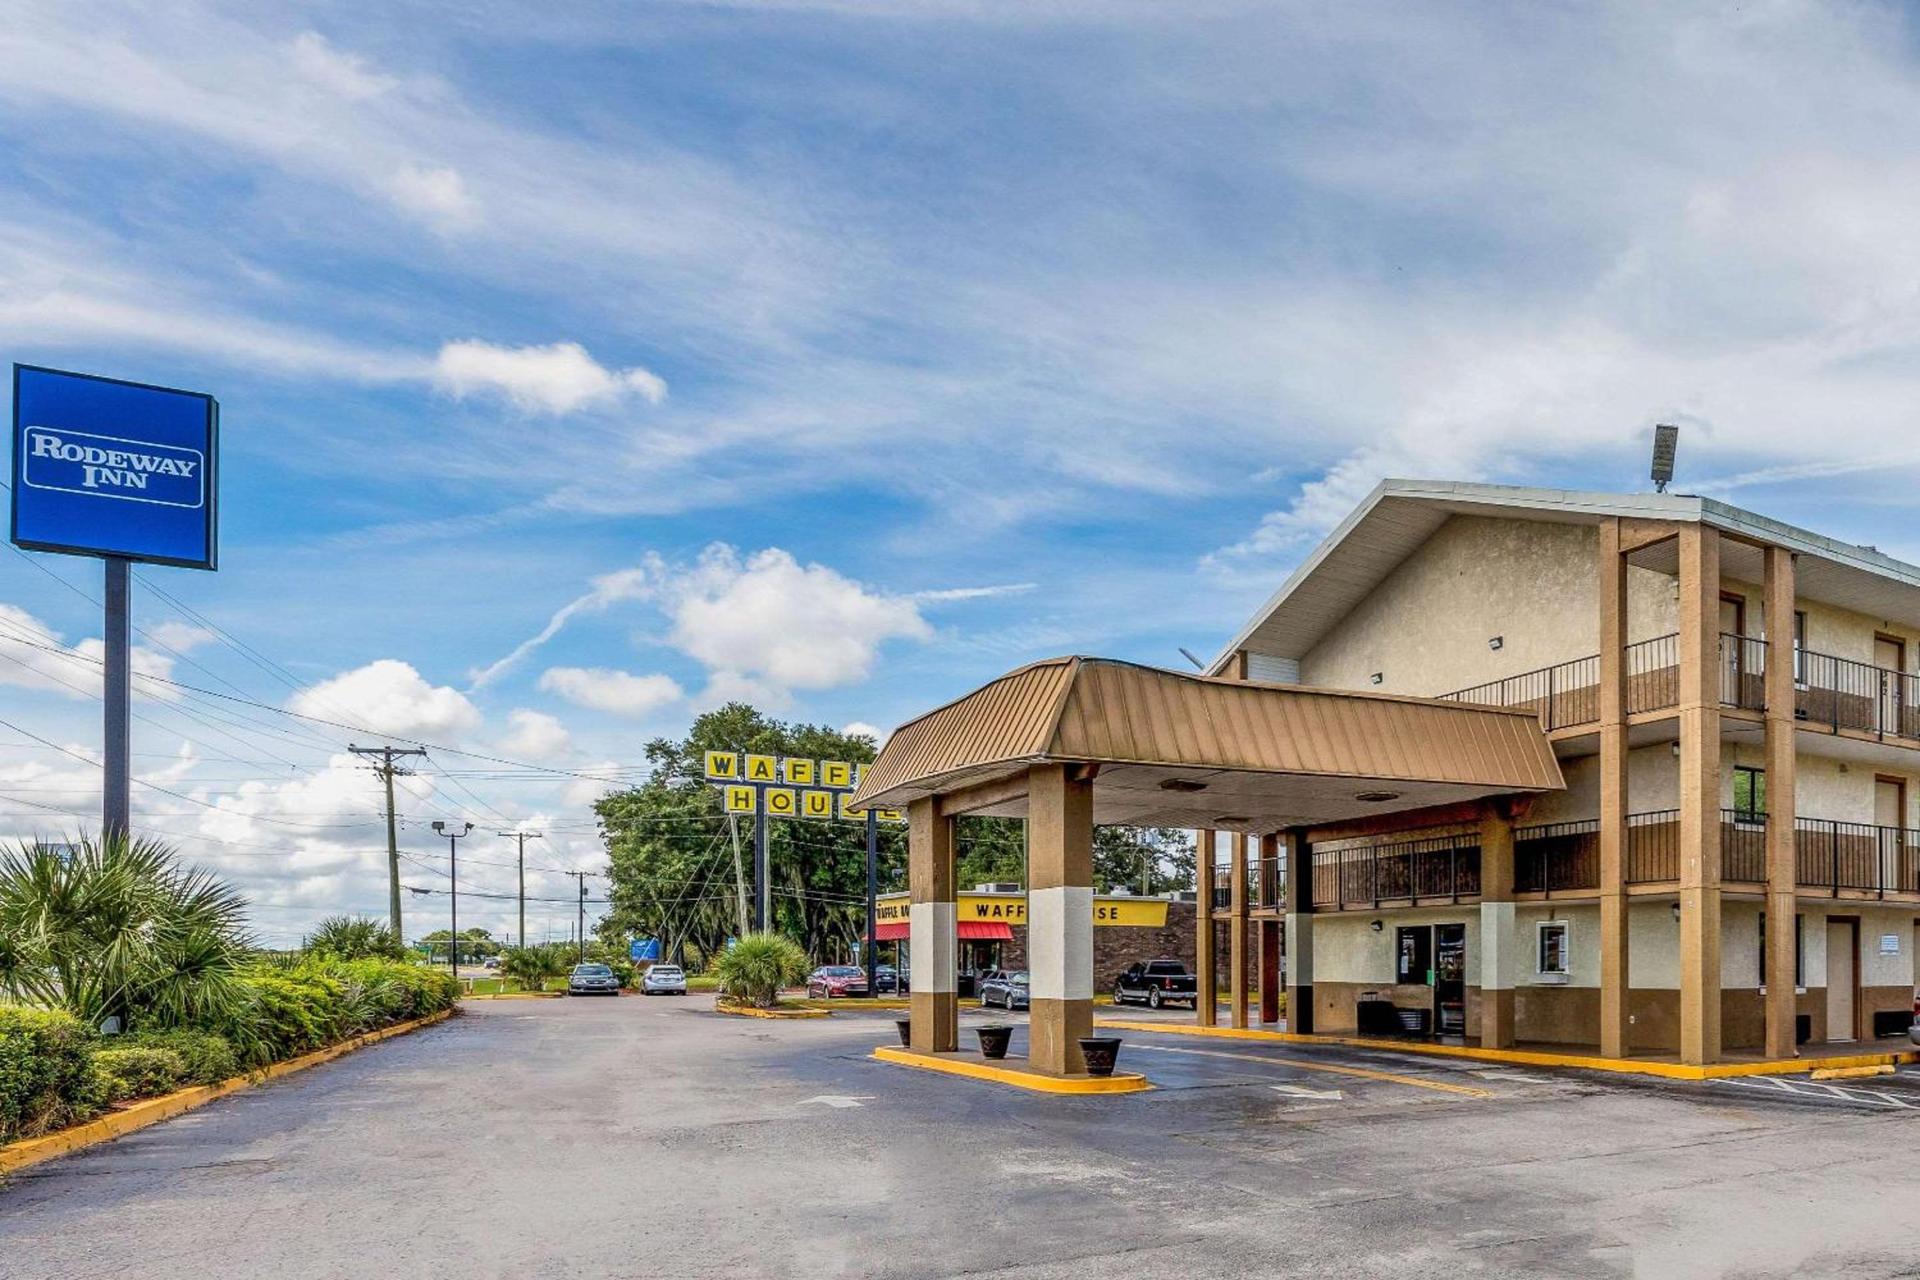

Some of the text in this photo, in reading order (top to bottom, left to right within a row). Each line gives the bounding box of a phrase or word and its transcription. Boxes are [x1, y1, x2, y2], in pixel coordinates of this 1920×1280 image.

[32, 433, 197, 478] RODEWAY
[82, 465, 149, 489] INN
[713, 756, 845, 783] WAFF
[976, 904, 1118, 920] WAFF SE
